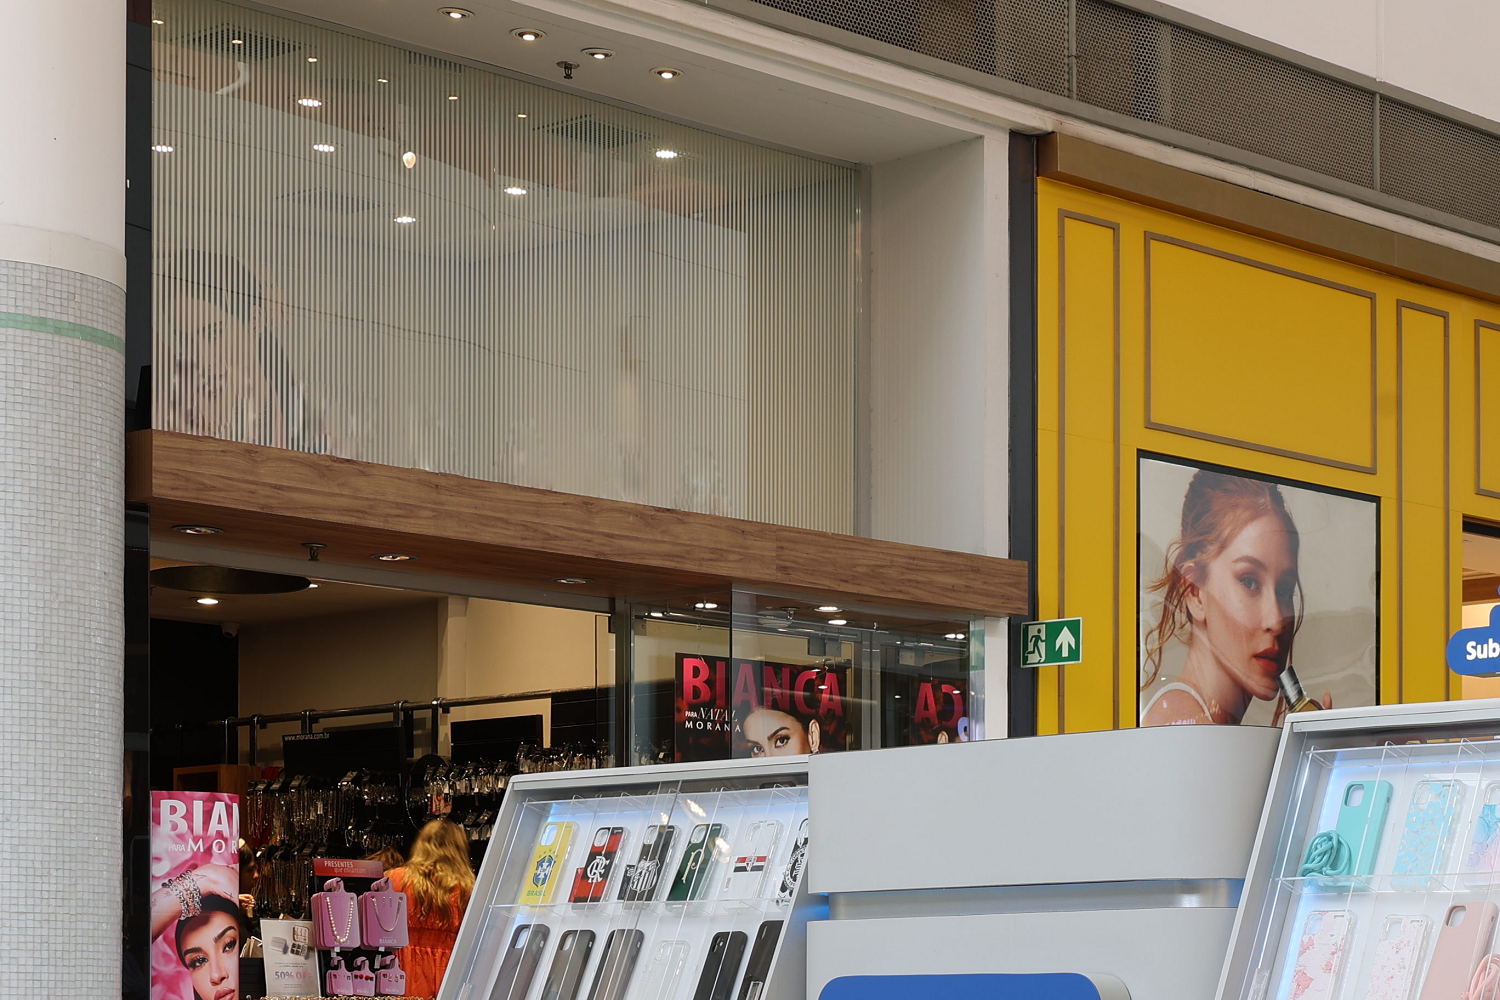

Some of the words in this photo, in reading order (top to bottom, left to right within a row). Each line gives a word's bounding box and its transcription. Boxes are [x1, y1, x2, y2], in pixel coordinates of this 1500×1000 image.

[683, 657, 843, 716] BIANCA
[685, 710, 698, 718] PARA
[697, 707, 739, 722] NATAL
[685, 720, 741, 733] MORANA
[168, 844, 186, 852] PARA
[324, 860, 354, 868] PRESENTES
[274, 970, 295, 979] 50%
